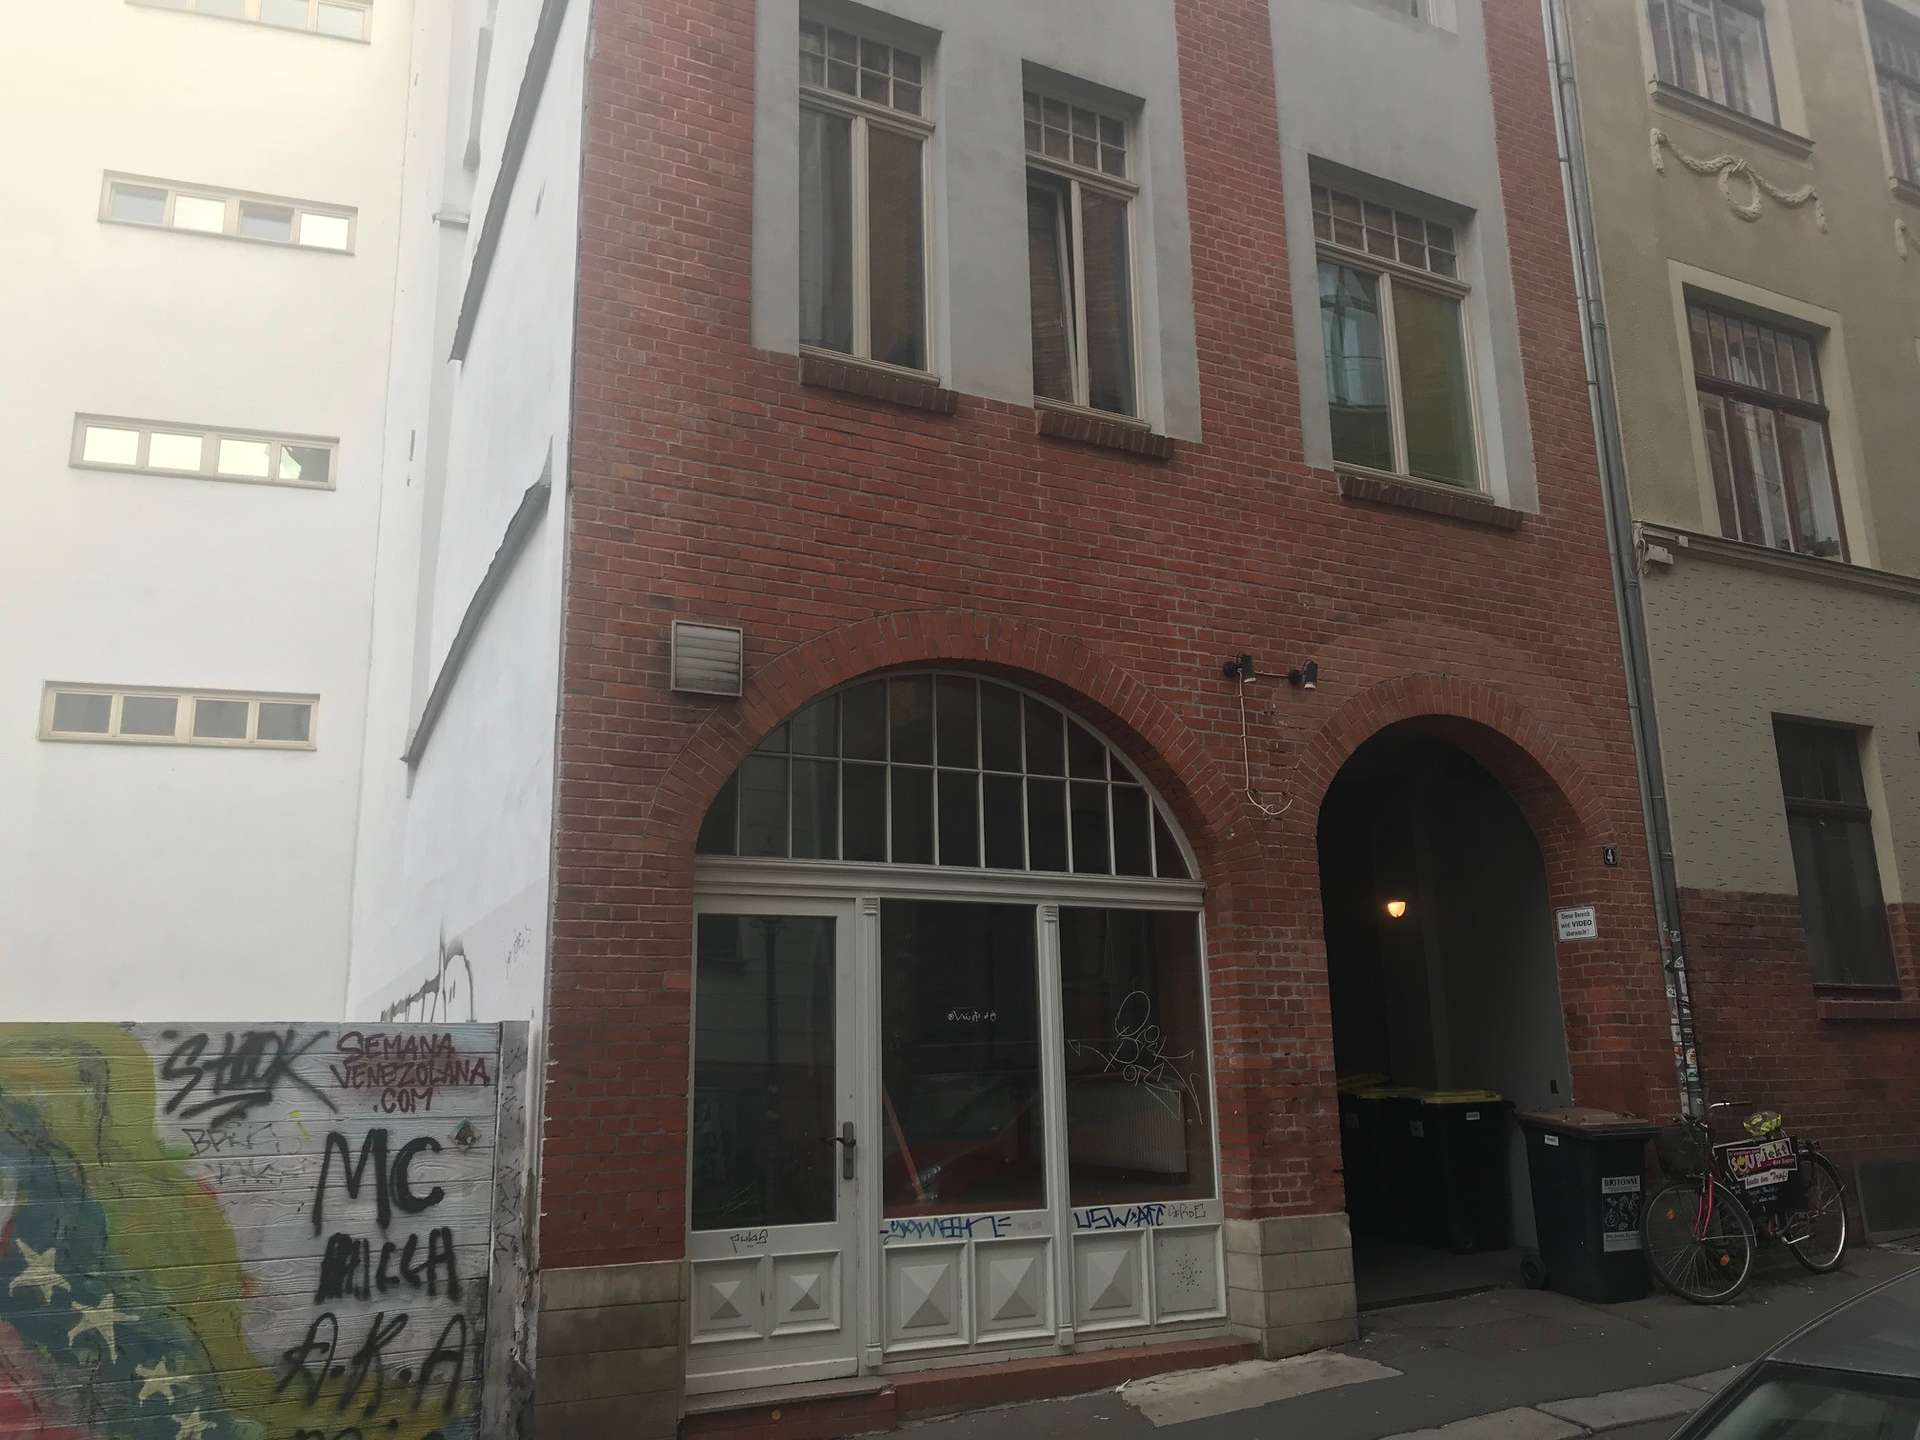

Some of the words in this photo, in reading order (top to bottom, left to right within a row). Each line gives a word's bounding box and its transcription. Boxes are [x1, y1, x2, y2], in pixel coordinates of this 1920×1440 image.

[1571, 919, 1592, 928] VIDEO
[336, 1031, 456, 1065] SEMANA
[329, 1058, 490, 1089] VENEZOLANA
[311, 1128, 446, 1237] MC
